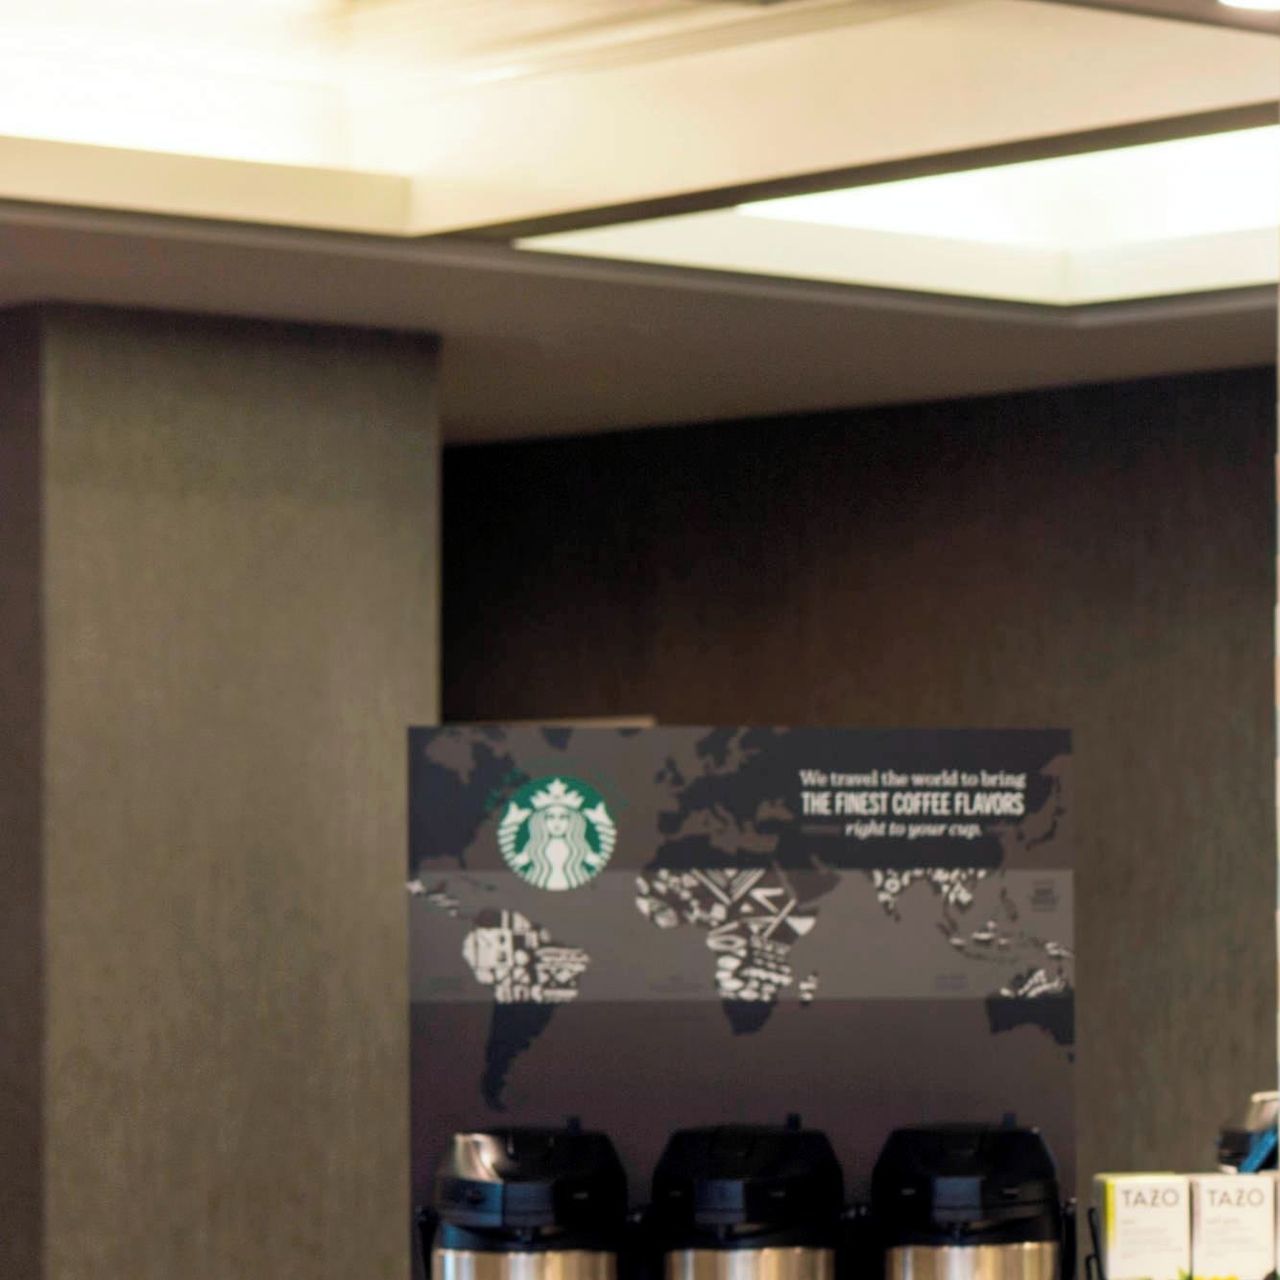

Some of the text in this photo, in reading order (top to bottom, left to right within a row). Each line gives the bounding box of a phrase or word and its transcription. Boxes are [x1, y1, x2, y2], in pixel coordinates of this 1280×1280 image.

[799, 769, 1027, 790] We travel the world to bring
[802, 791, 1025, 816] THE FINEST COFFEE FLAVORS
[845, 819, 982, 840] right to your cup.
[1122, 1189, 1180, 1208] TAZO
[1208, 1187, 1265, 1207] TAZO
